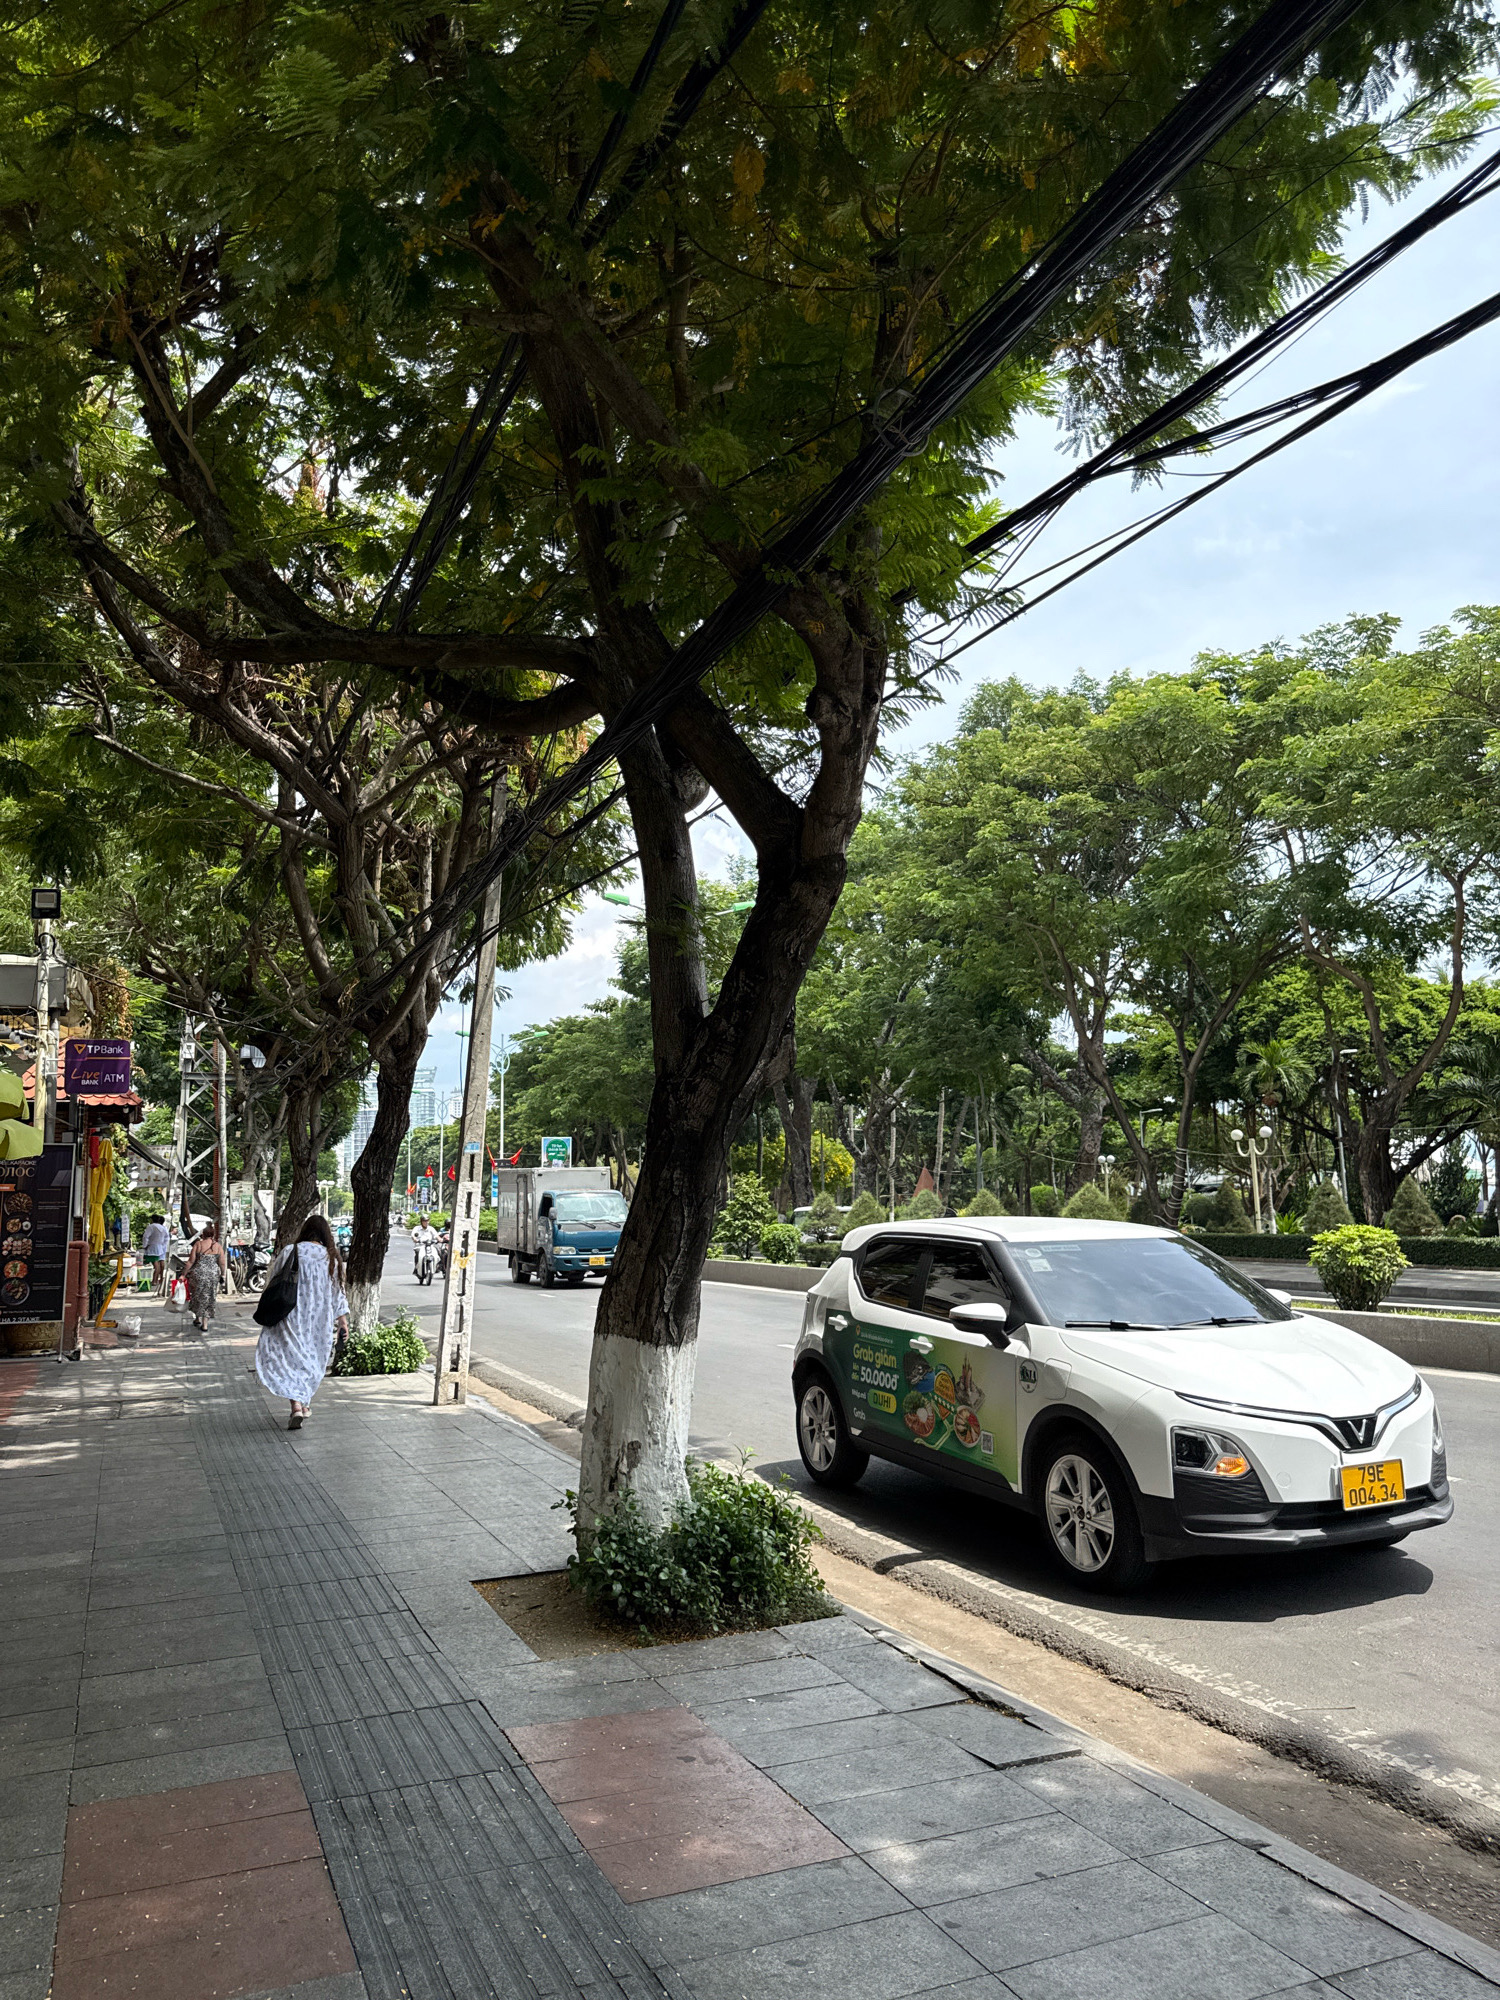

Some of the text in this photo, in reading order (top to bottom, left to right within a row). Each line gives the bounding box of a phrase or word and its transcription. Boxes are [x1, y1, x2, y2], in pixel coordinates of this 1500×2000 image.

[87, 1044, 124, 1054] TPBank
[71, 1067, 124, 1083] Live ATM
[853, 1343, 874, 1363] Grab
[853, 1407, 866, 1421] Grab
[1358, 1464, 1385, 1485] 79E
[1349, 1482, 1398, 1506] 004.34
